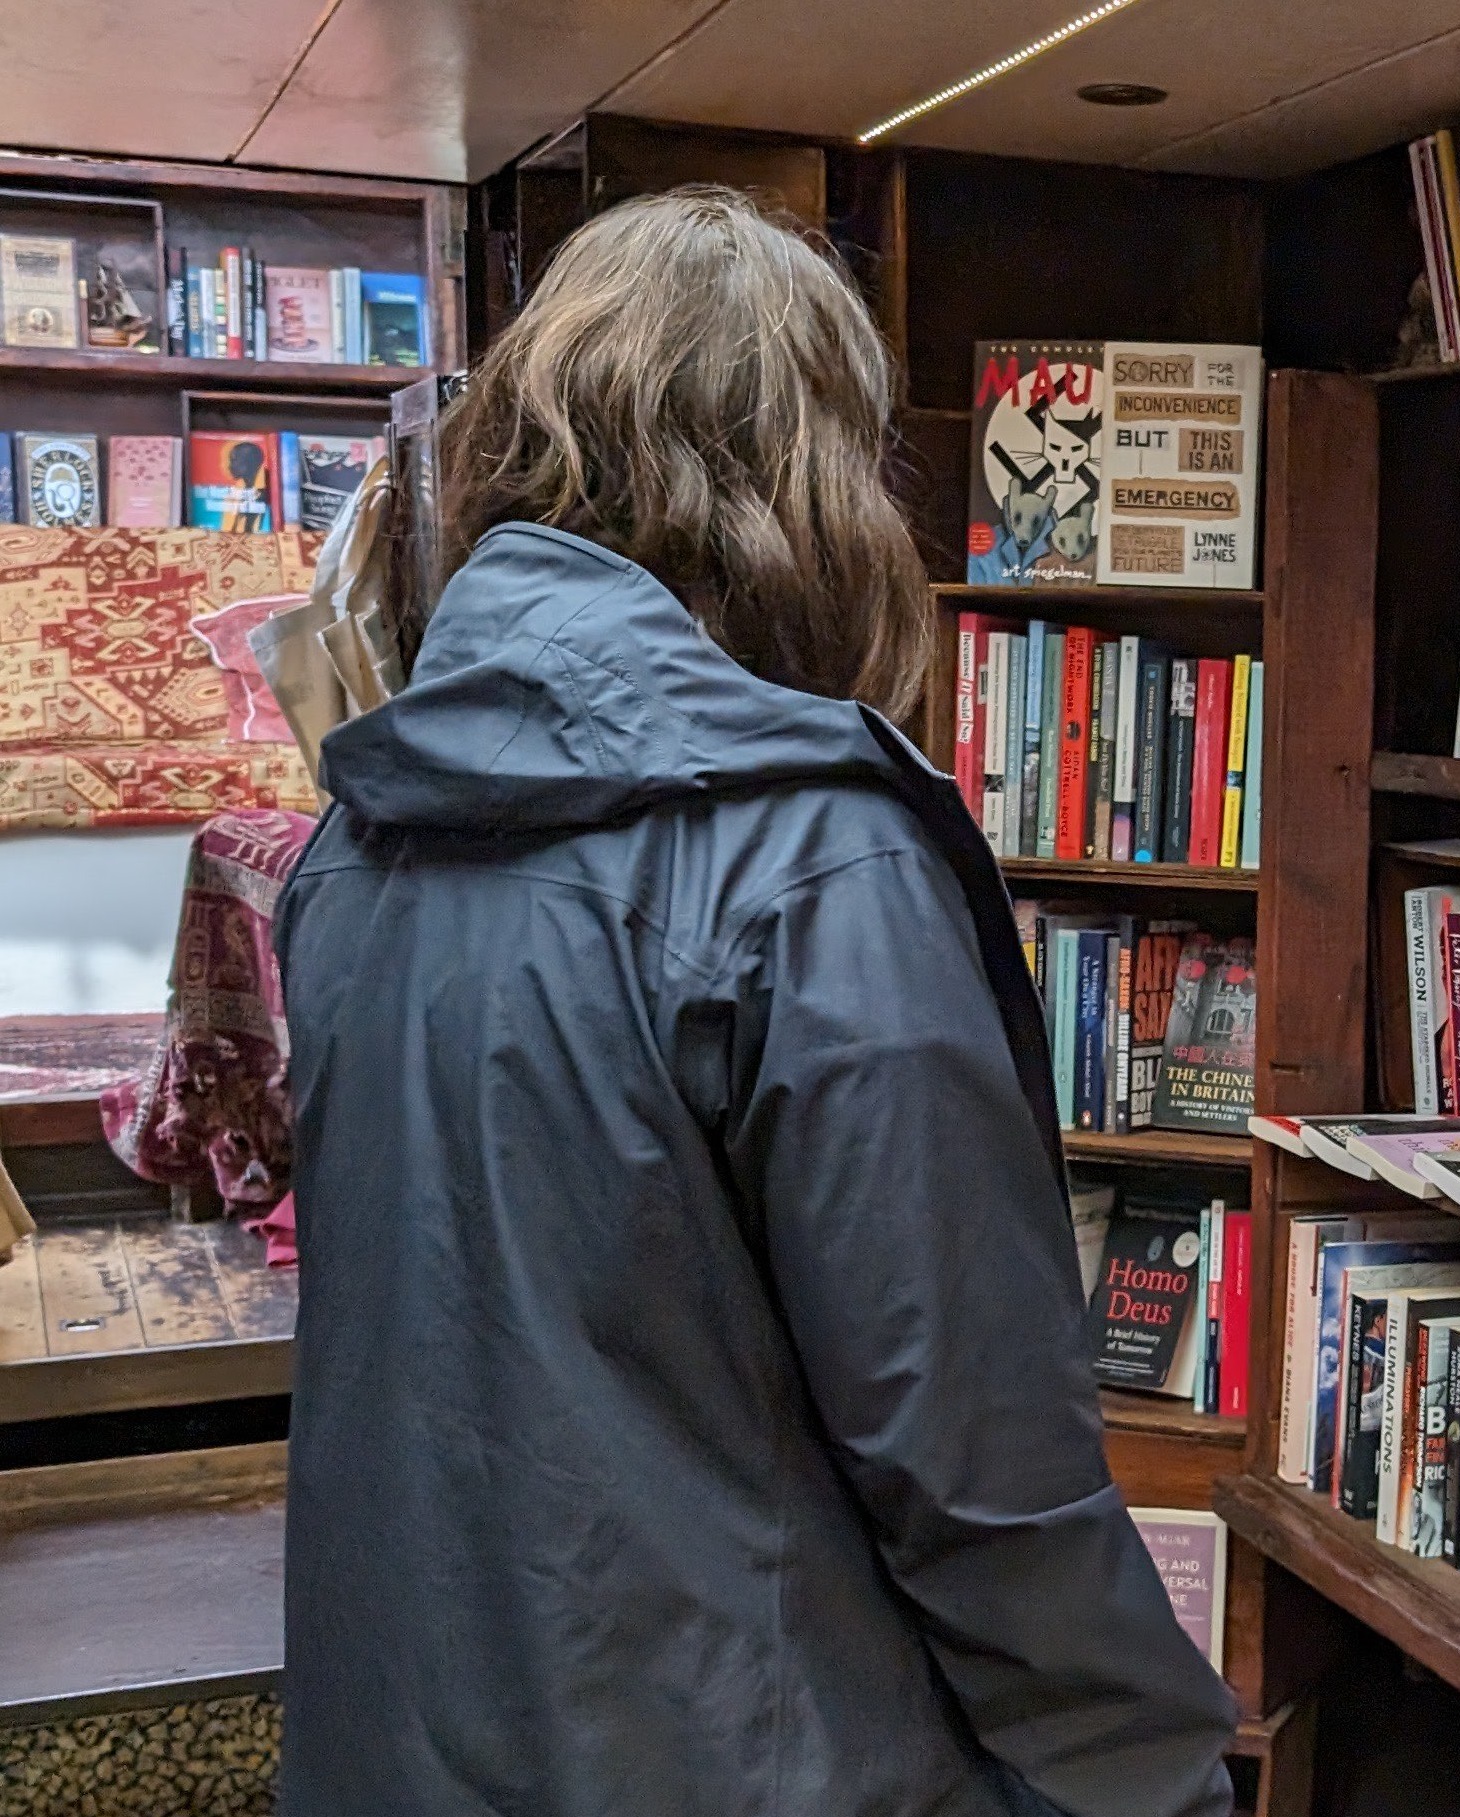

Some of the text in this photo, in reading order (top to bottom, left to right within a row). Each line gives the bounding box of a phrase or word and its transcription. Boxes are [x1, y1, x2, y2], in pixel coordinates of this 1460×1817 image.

[1114, 360, 1194, 384] SORRY
[975, 356, 1094, 409] MAU
[1118, 399, 1238, 416] INCONVENIENCE
[1116, 429, 1232, 450] BUT THIS
[1188, 452, 1235, 471] IS AN
[1114, 489, 1236, 508] EMERGENCY
[1193, 531, 1237, 547] LYNNE
[1001, 564, 1021, 578] art
[958, 632, 975, 723] Because Said
[1413, 935, 1427, 1002] WILSON
[1167, 1066, 1198, 1082] THE
[1170, 1082, 1188, 1096] IN
[1202, 1111, 1238, 1122] SETTLERS
[1106, 1257, 1190, 1295] Homo
[1106, 1290, 1173, 1325] Deus
[1382, 1318, 1398, 1475] ILLUMINATIONS
